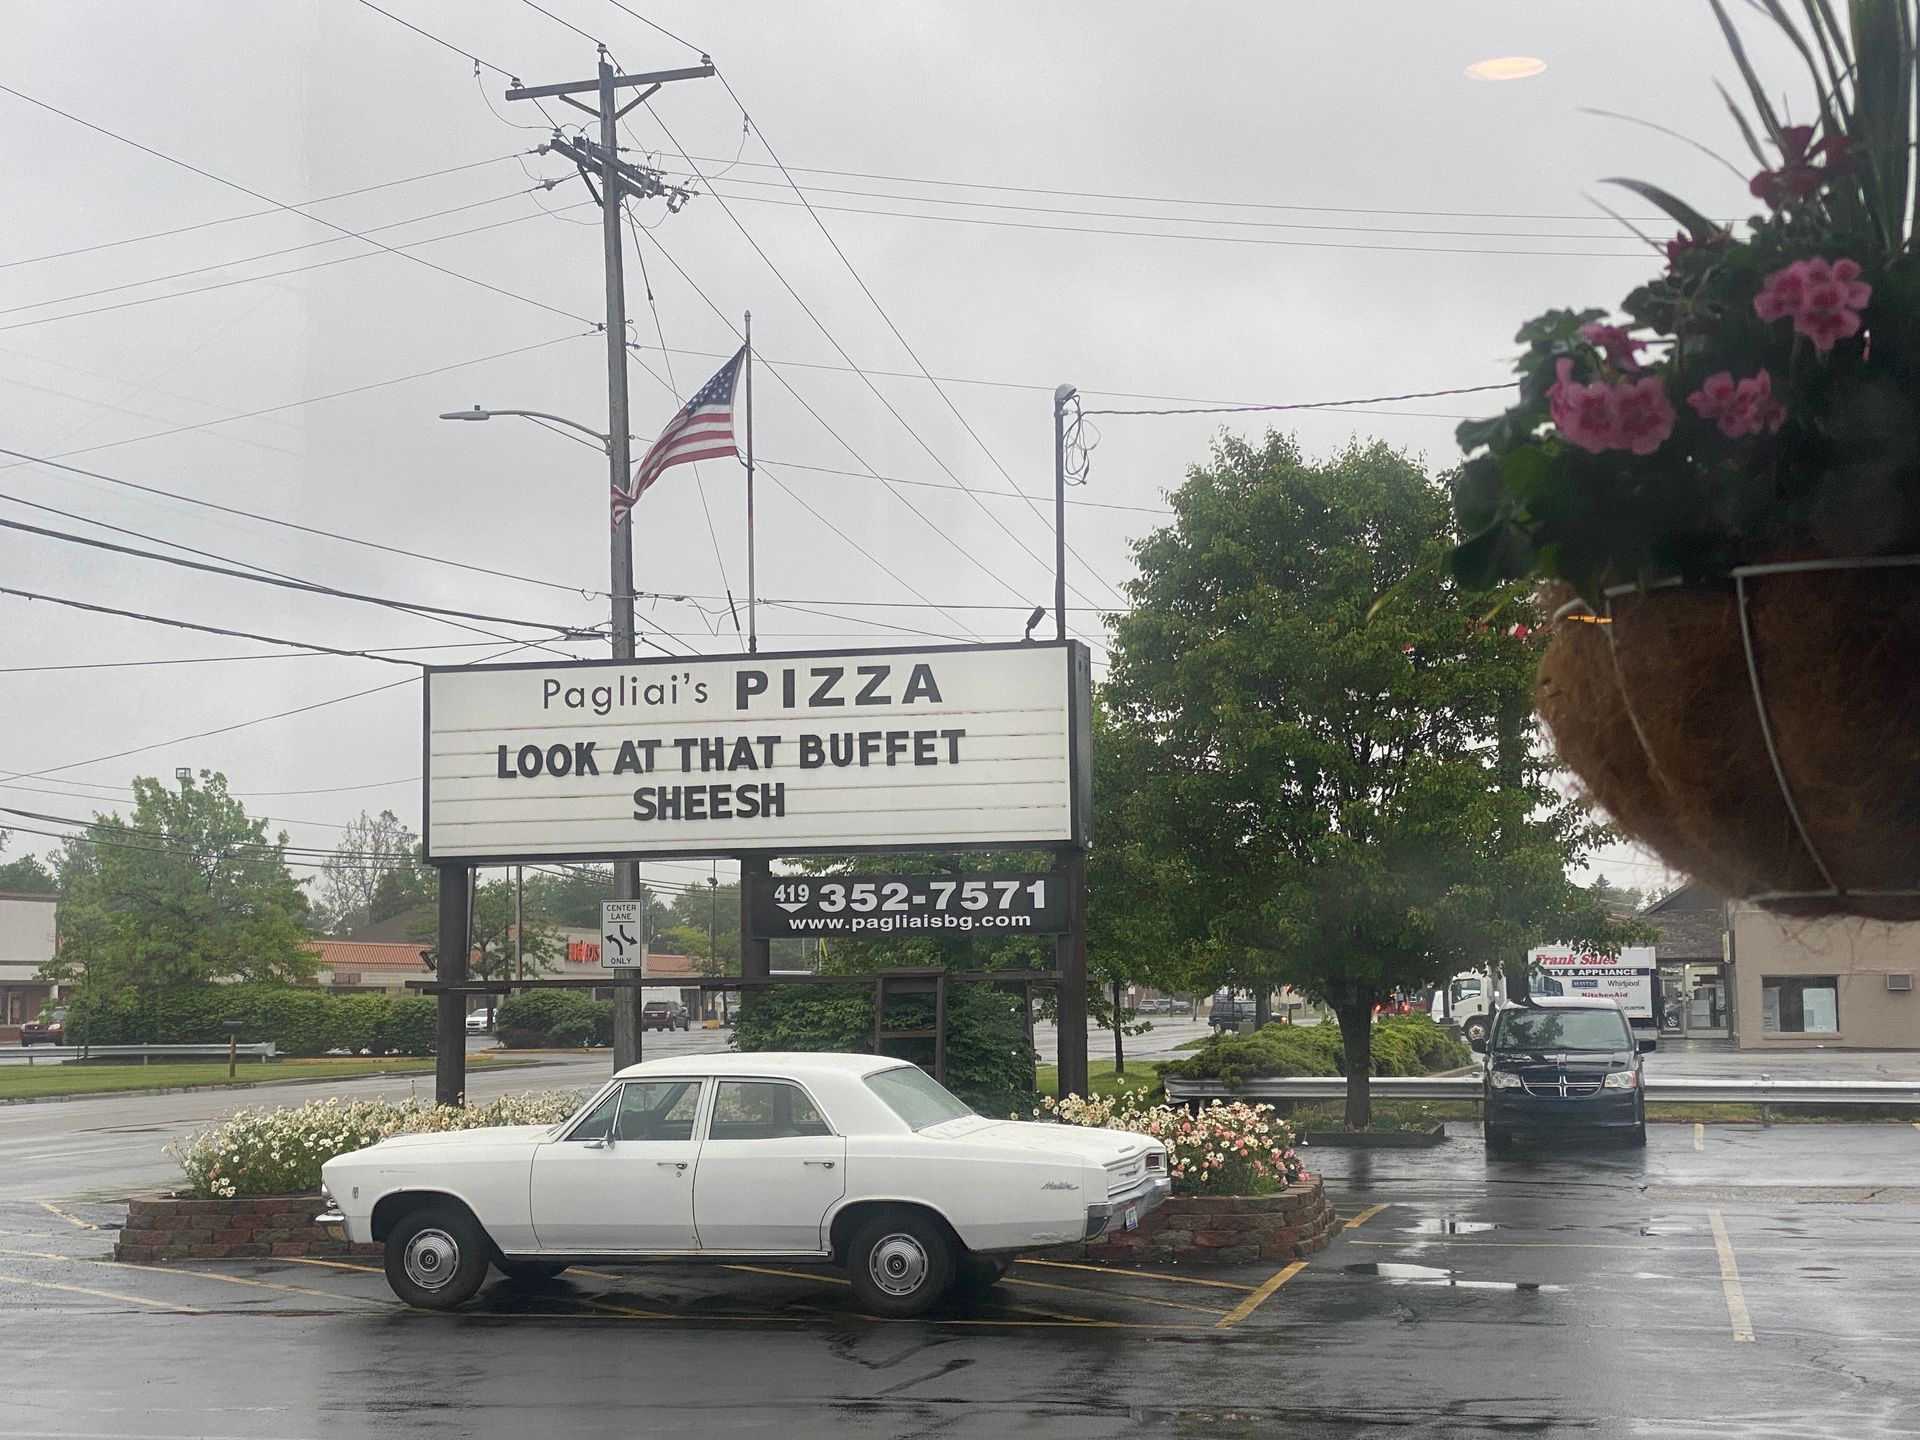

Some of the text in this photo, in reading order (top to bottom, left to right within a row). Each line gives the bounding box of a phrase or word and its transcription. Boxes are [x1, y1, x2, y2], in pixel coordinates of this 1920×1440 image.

[543, 663, 943, 716] Pagliai's PIZZA
[497, 728, 966, 779] LOOK AT THAT BUFFET
[633, 782, 785, 821] SHEESH
[773, 879, 1046, 913] 419 352-7571
[606, 904, 637, 912] CENTER
[788, 913, 1031, 932] www.pagliaisbg.com
[610, 957, 632, 965] ONLY
[1535, 954, 1576, 965] Frank
[1578, 968, 1638, 976] APPLIANCE
[1607, 980, 1640, 988] Whirlpool
